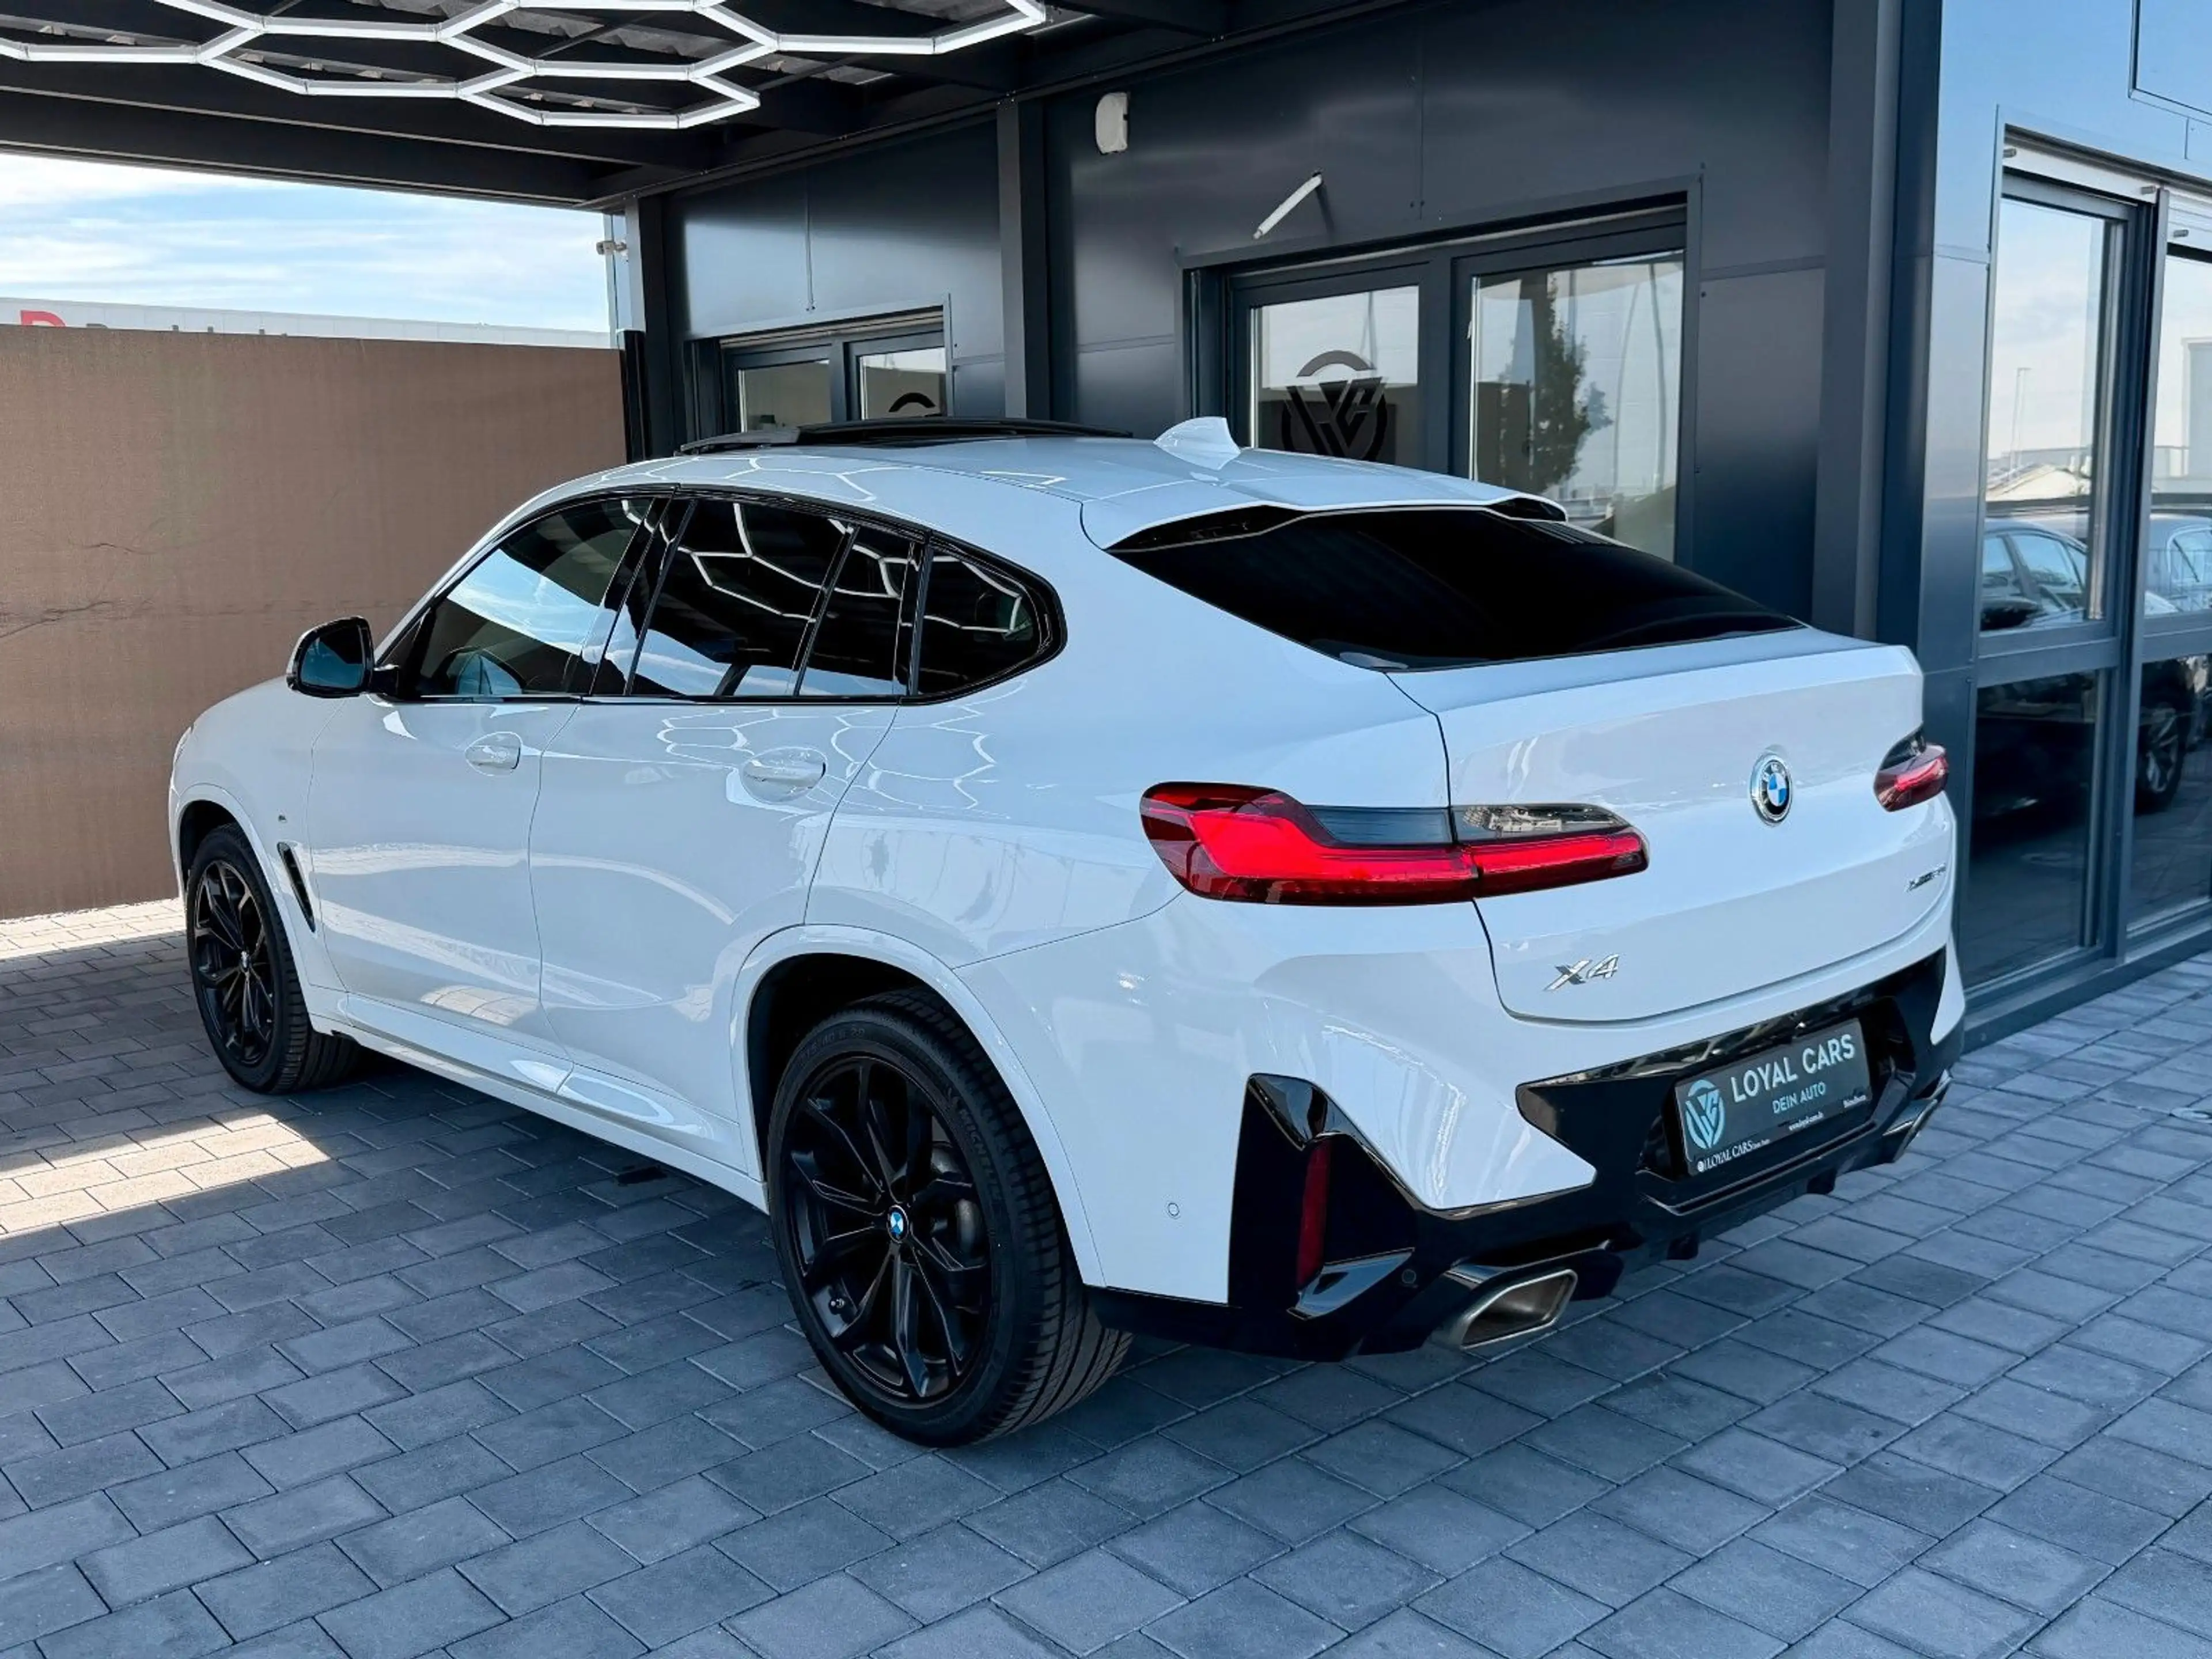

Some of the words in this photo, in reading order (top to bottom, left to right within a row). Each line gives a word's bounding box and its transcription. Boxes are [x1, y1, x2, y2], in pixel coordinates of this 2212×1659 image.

[1543, 954, 1619, 991] X4
[1730, 1057, 1798, 1103] LOYAL
[1802, 1034, 1855, 1074] CARS
[1772, 1093, 1797, 1113] DEIN
[1800, 1082, 1826, 1104] AUTO
[1707, 1149, 1732, 1169] LOYAL
[1732, 1141, 1752, 1157] CARS
